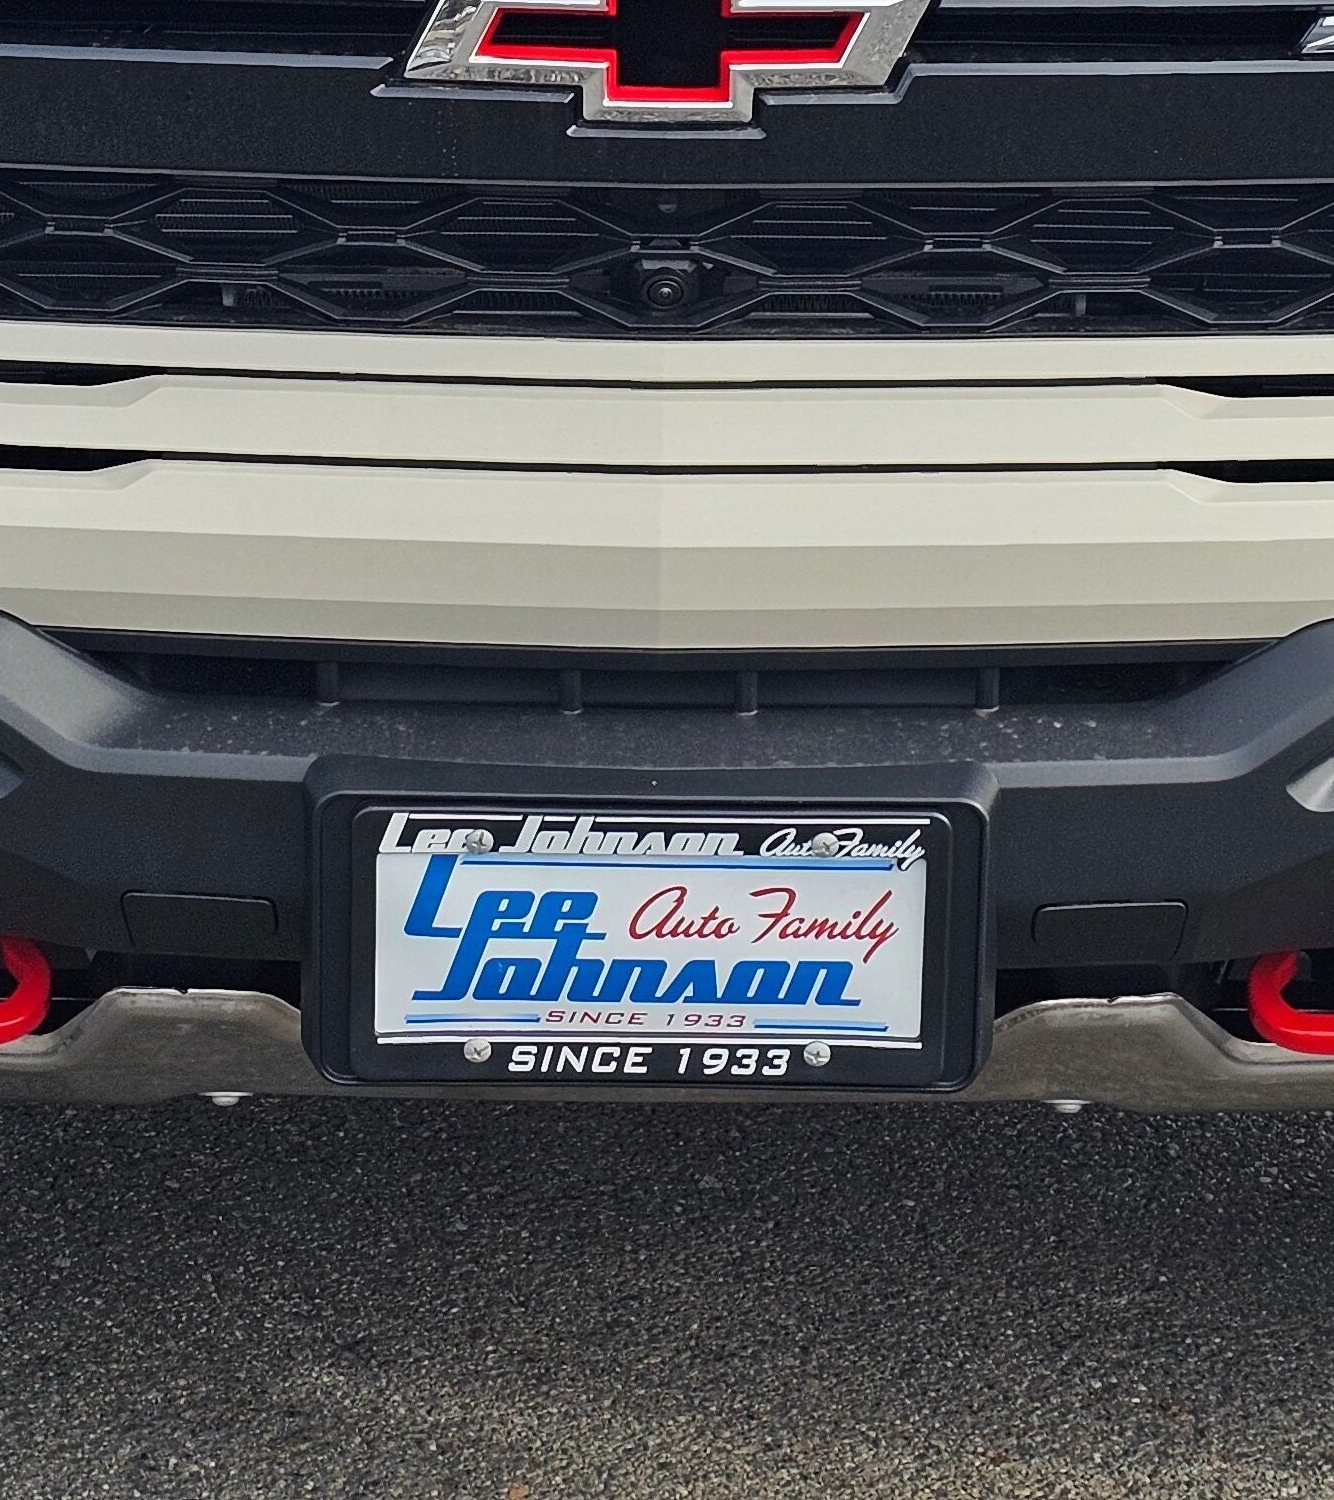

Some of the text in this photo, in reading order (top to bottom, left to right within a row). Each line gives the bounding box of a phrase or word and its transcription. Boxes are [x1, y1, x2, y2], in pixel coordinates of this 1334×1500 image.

[499, 815, 745, 856] Johnson
[759, 827, 817, 858] Aut
[831, 827, 926, 872] Family
[403, 853, 608, 941] Lee
[628, 885, 900, 964] Auto Family
[411, 924, 863, 1006] Johnson
[544, 1010, 748, 1029] SINCE 1933
[507, 1044, 791, 1077] SINCE 1933
